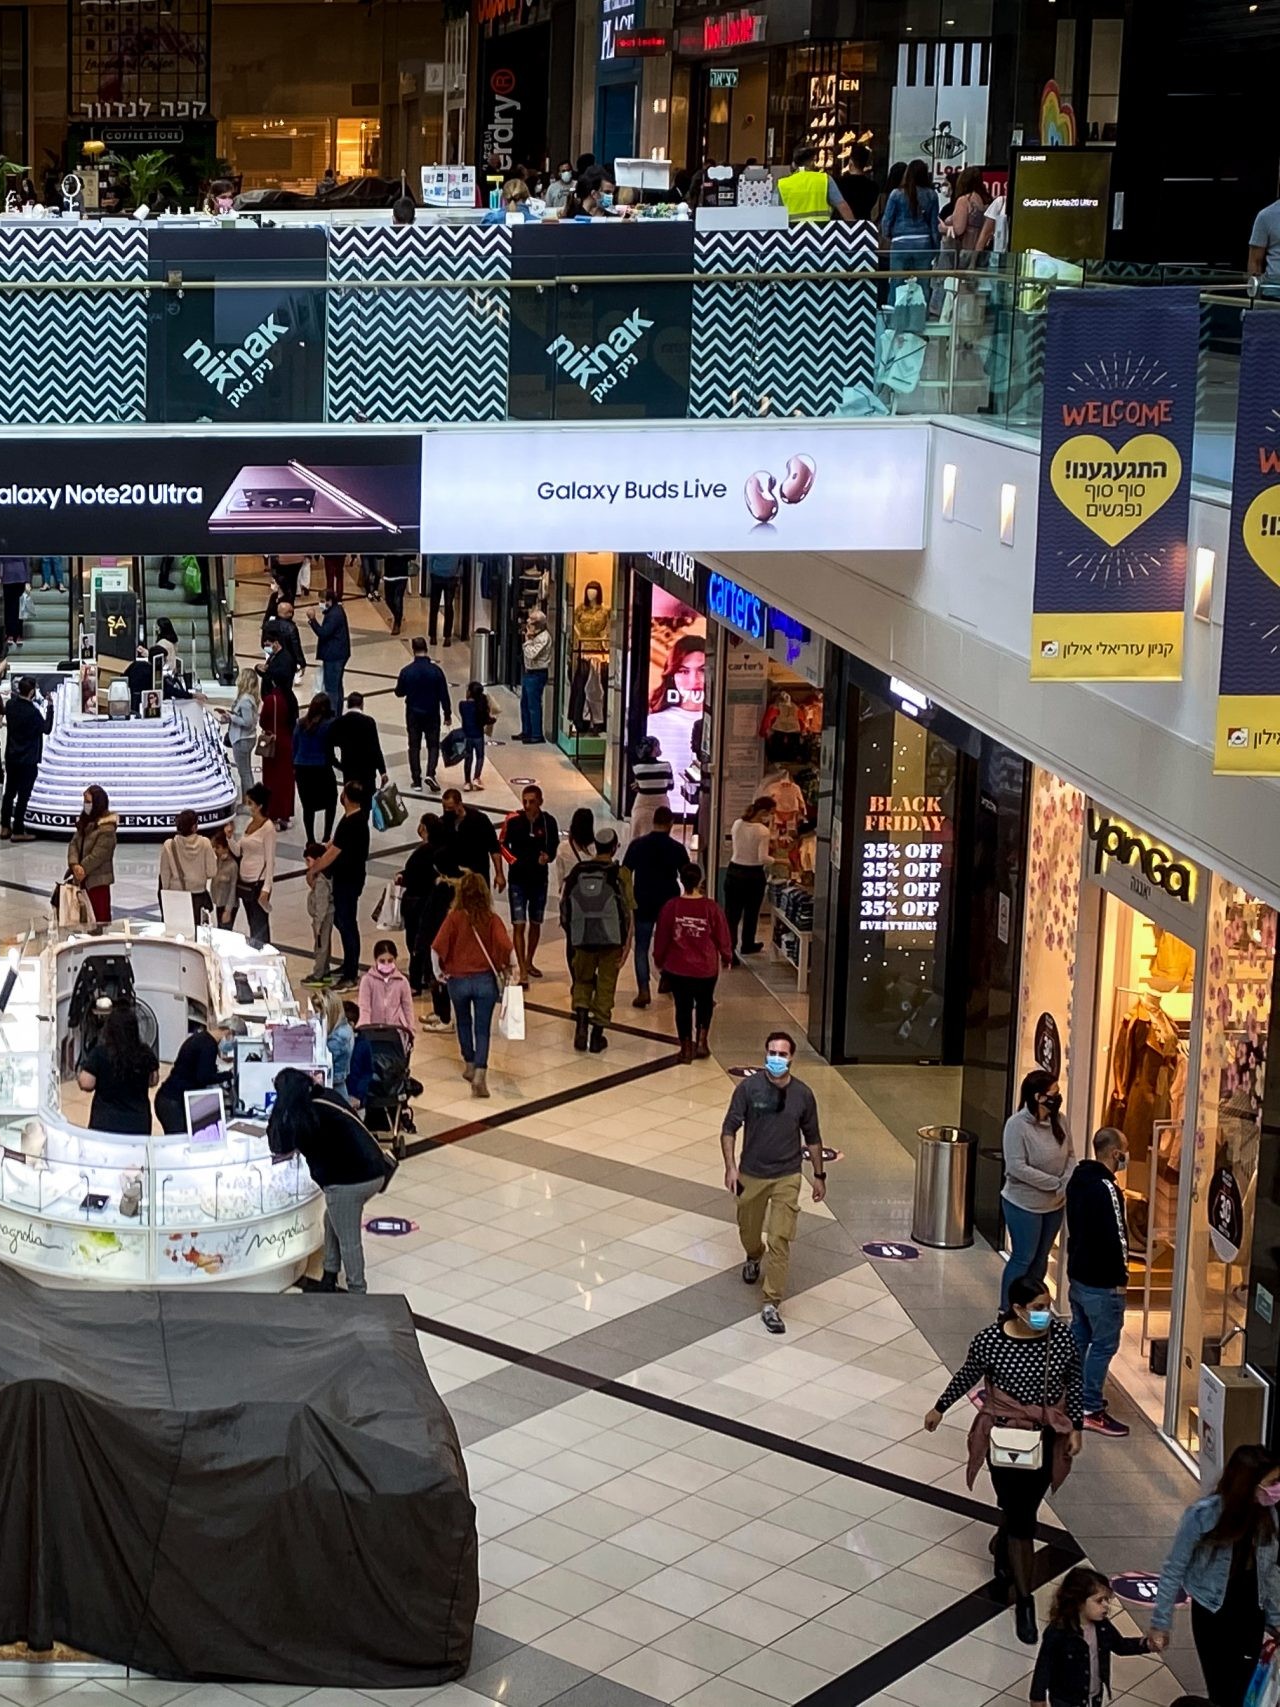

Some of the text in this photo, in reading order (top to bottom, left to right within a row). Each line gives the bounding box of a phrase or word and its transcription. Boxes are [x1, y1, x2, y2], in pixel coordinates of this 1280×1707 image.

[80, 98, 207, 119] קפה לנדוור
[106, 132, 144, 140] COFFEE
[1062, 399, 1173, 427] WELCOME
[1065, 460, 1167, 481] התגעגענו!
[65, 484, 145, 504] Note20
[148, 484, 203, 504] Ultra
[537, 478, 727, 504] Galaxy Buds Live
[1085, 483, 1145, 501] סוף סוף
[1086, 503, 1142, 517] נפגשים
[1062, 641, 1173, 658] קניון עזריאלי אילון
[728, 662, 764, 671] carter's
[870, 796, 942, 812] BLACK
[198, 813, 219, 824] RLIN
[865, 815, 946, 832] FRIDAY
[863, 843, 943, 859] 35% OFF
[862, 862, 942, 878] 35% OFF
[861, 881, 941, 897] 35% OFF
[860, 900, 940, 916] 35% OFF
